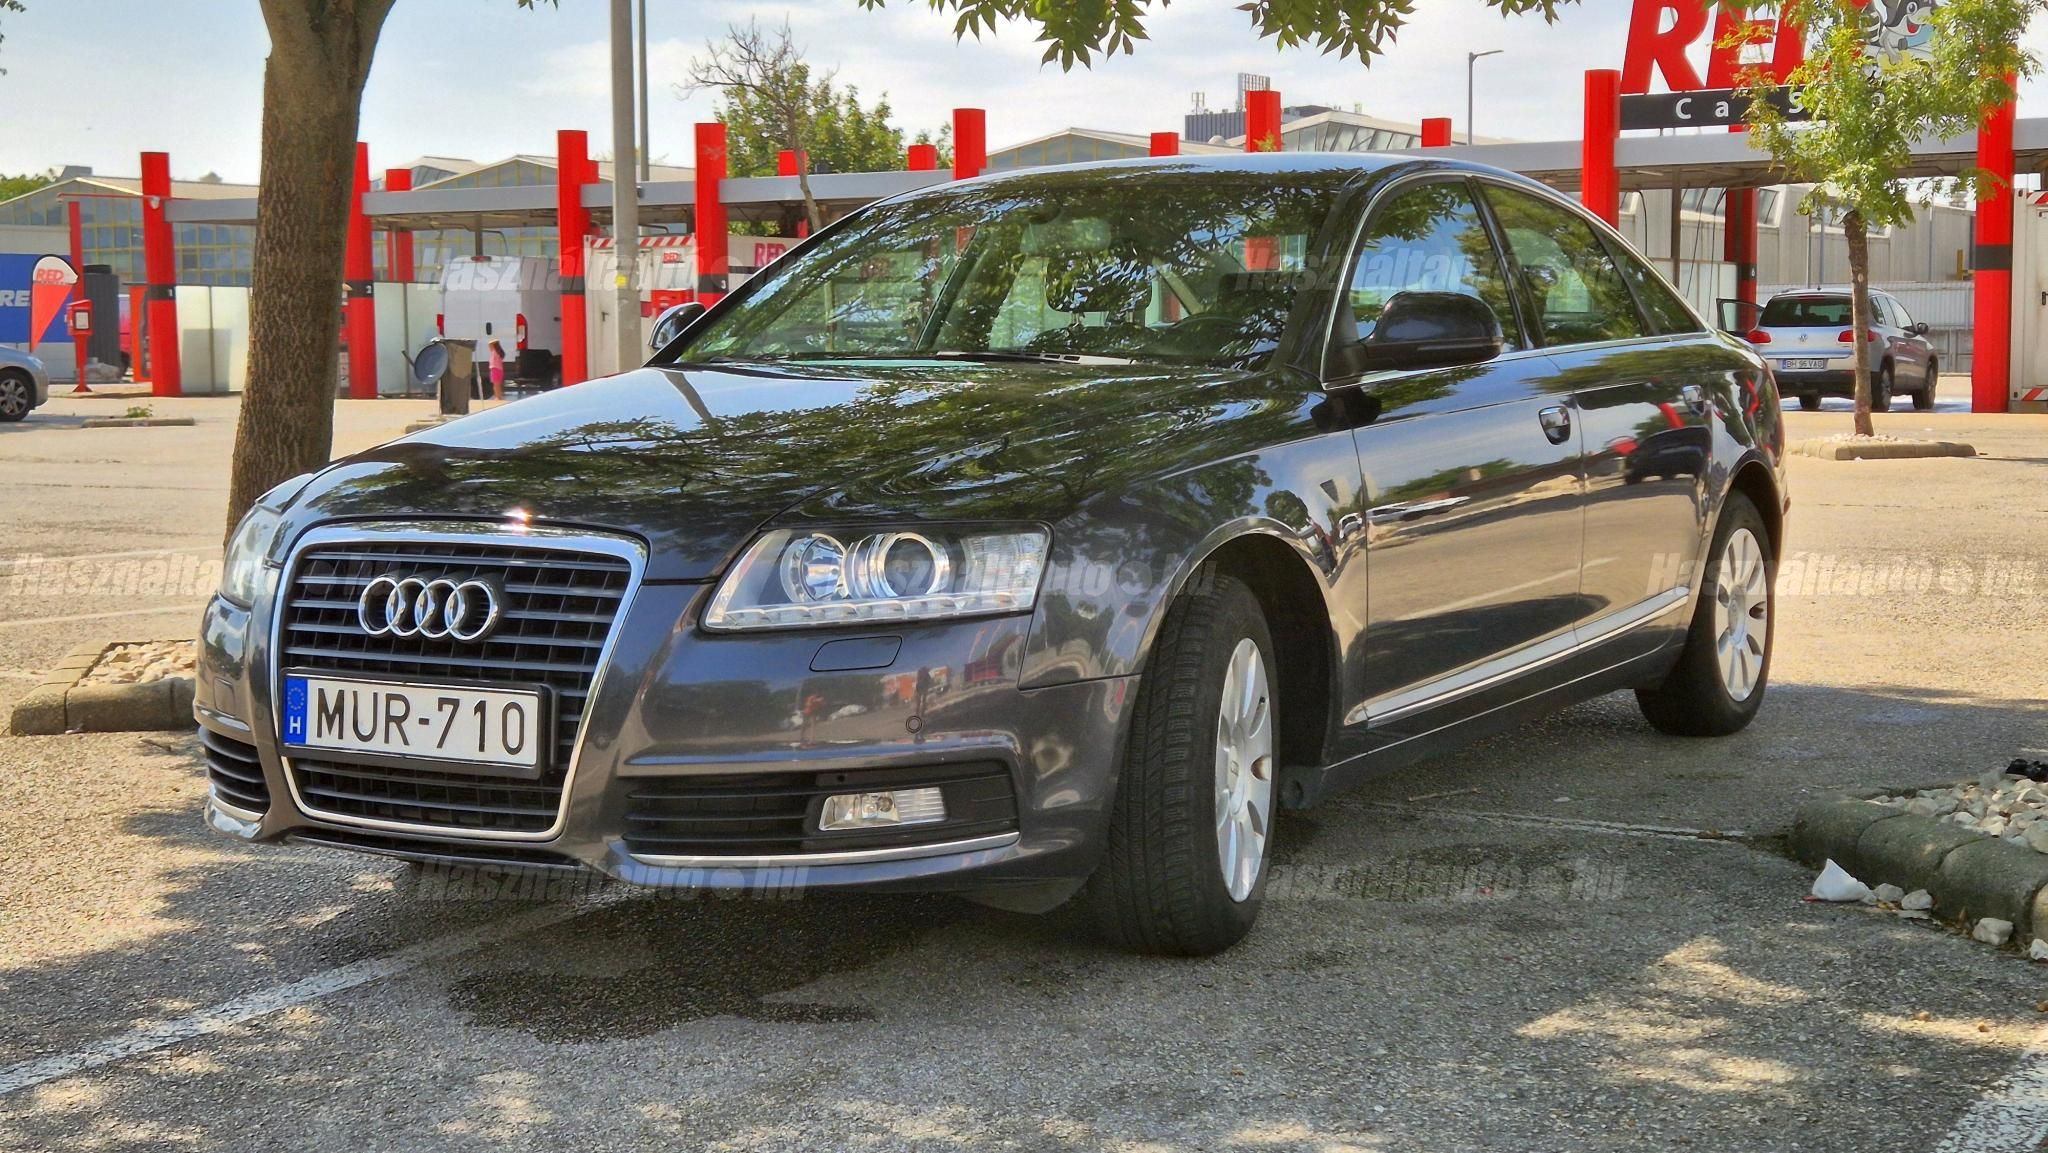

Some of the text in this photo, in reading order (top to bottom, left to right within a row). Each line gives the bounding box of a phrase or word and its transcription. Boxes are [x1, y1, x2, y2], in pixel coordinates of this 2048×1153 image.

[36, 268, 64, 281] RED
[289, 716, 301, 734] H
[316, 687, 525, 755] MUR-710
